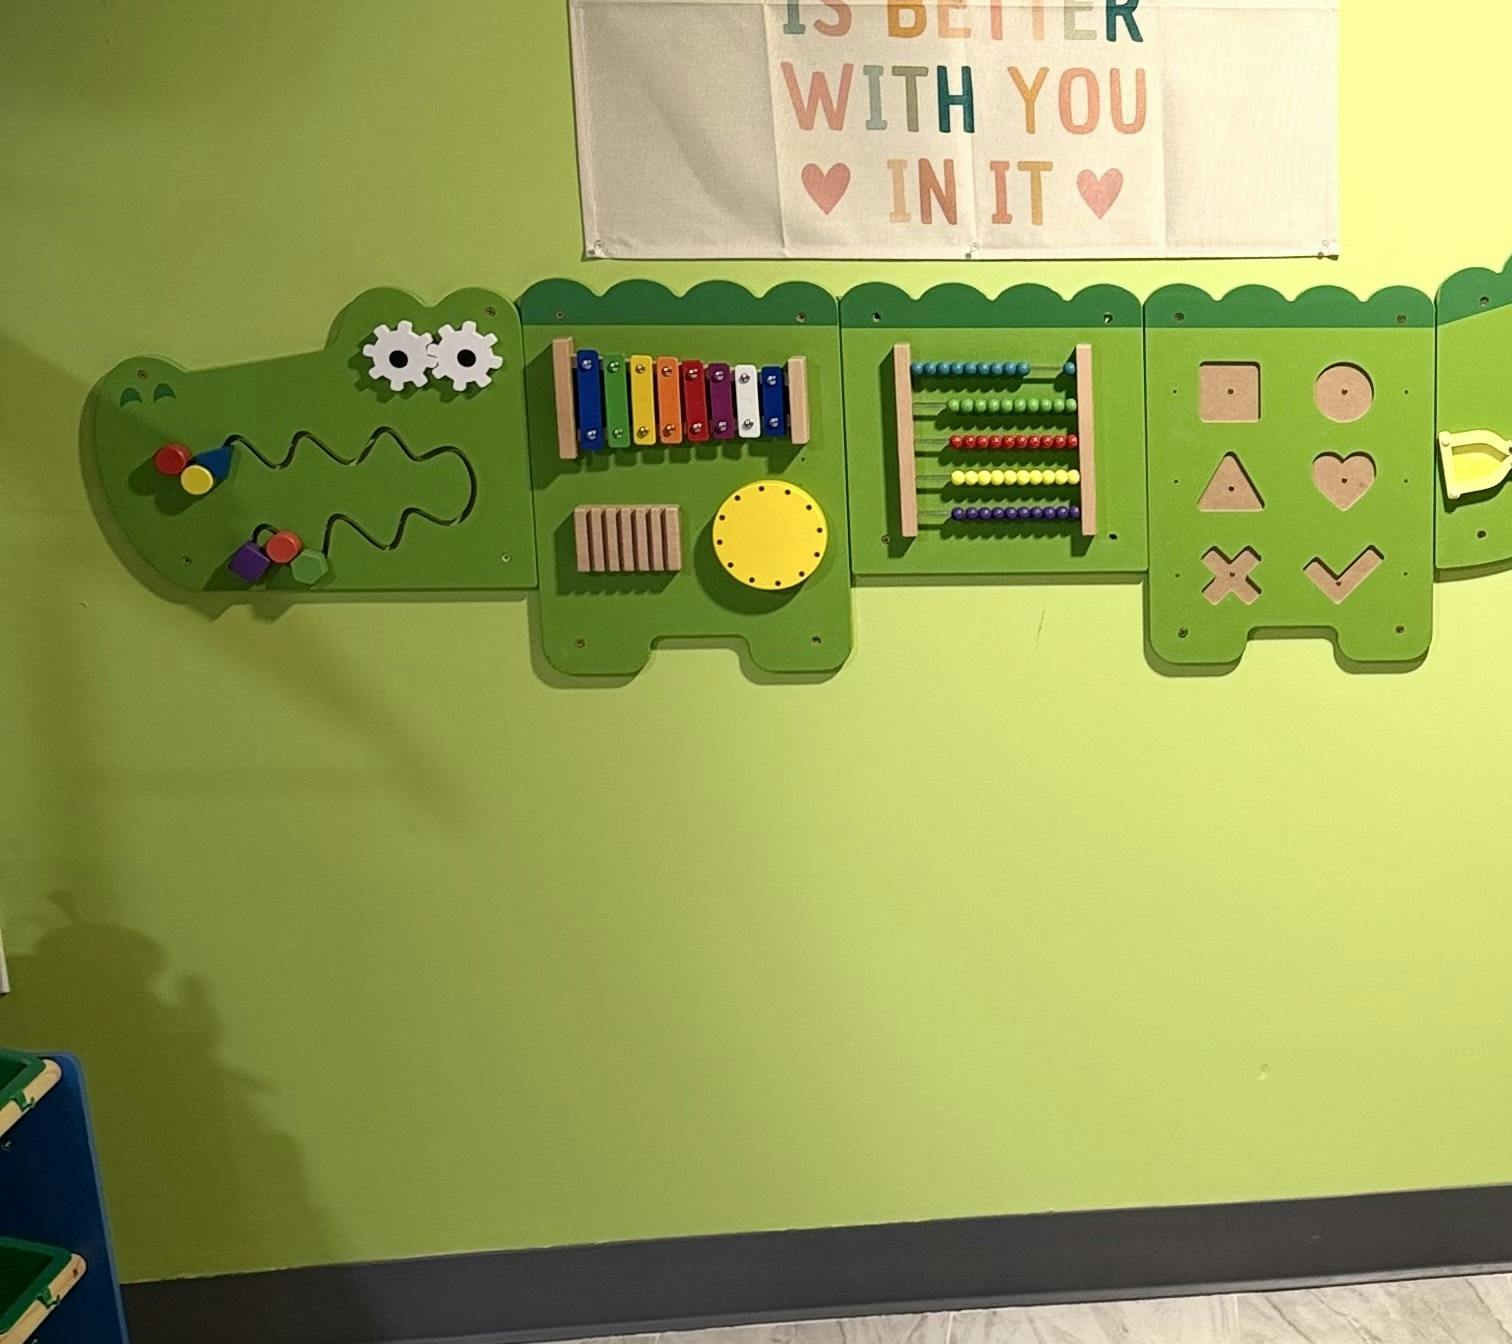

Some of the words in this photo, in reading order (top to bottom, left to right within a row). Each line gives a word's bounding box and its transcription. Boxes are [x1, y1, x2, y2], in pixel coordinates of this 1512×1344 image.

[781, 62, 975, 134] WITH
[1008, 66, 1147, 135] YOU
[889, 158, 958, 225] IN
[989, 160, 1053, 225] IT
